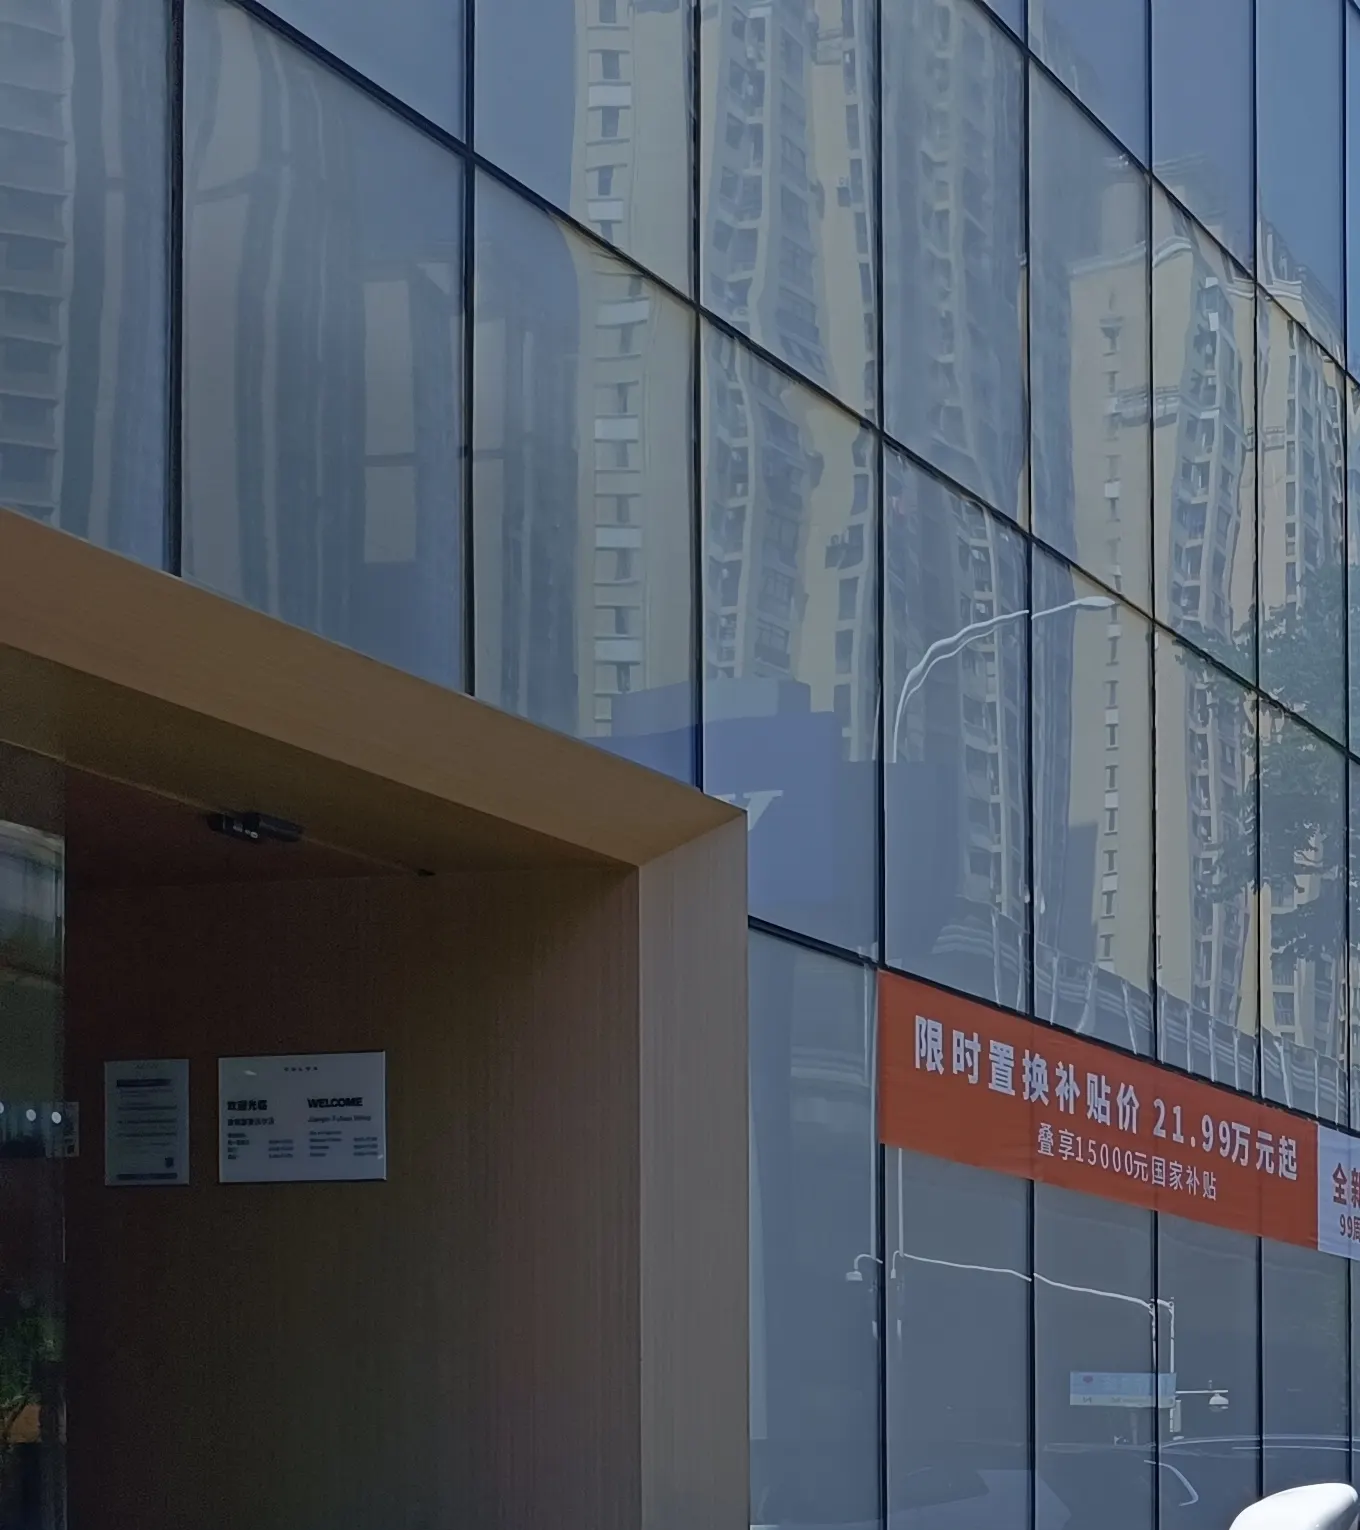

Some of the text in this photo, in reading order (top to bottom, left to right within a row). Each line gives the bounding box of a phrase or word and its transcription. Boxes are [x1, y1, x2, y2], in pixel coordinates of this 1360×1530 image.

[307, 1096, 363, 1108] WELCOME
[914, 1014, 1299, 1182] 限时置换补贴价 21.99万元起
[1036, 1121, 1218, 1202] 叠享15000元国家补贴
